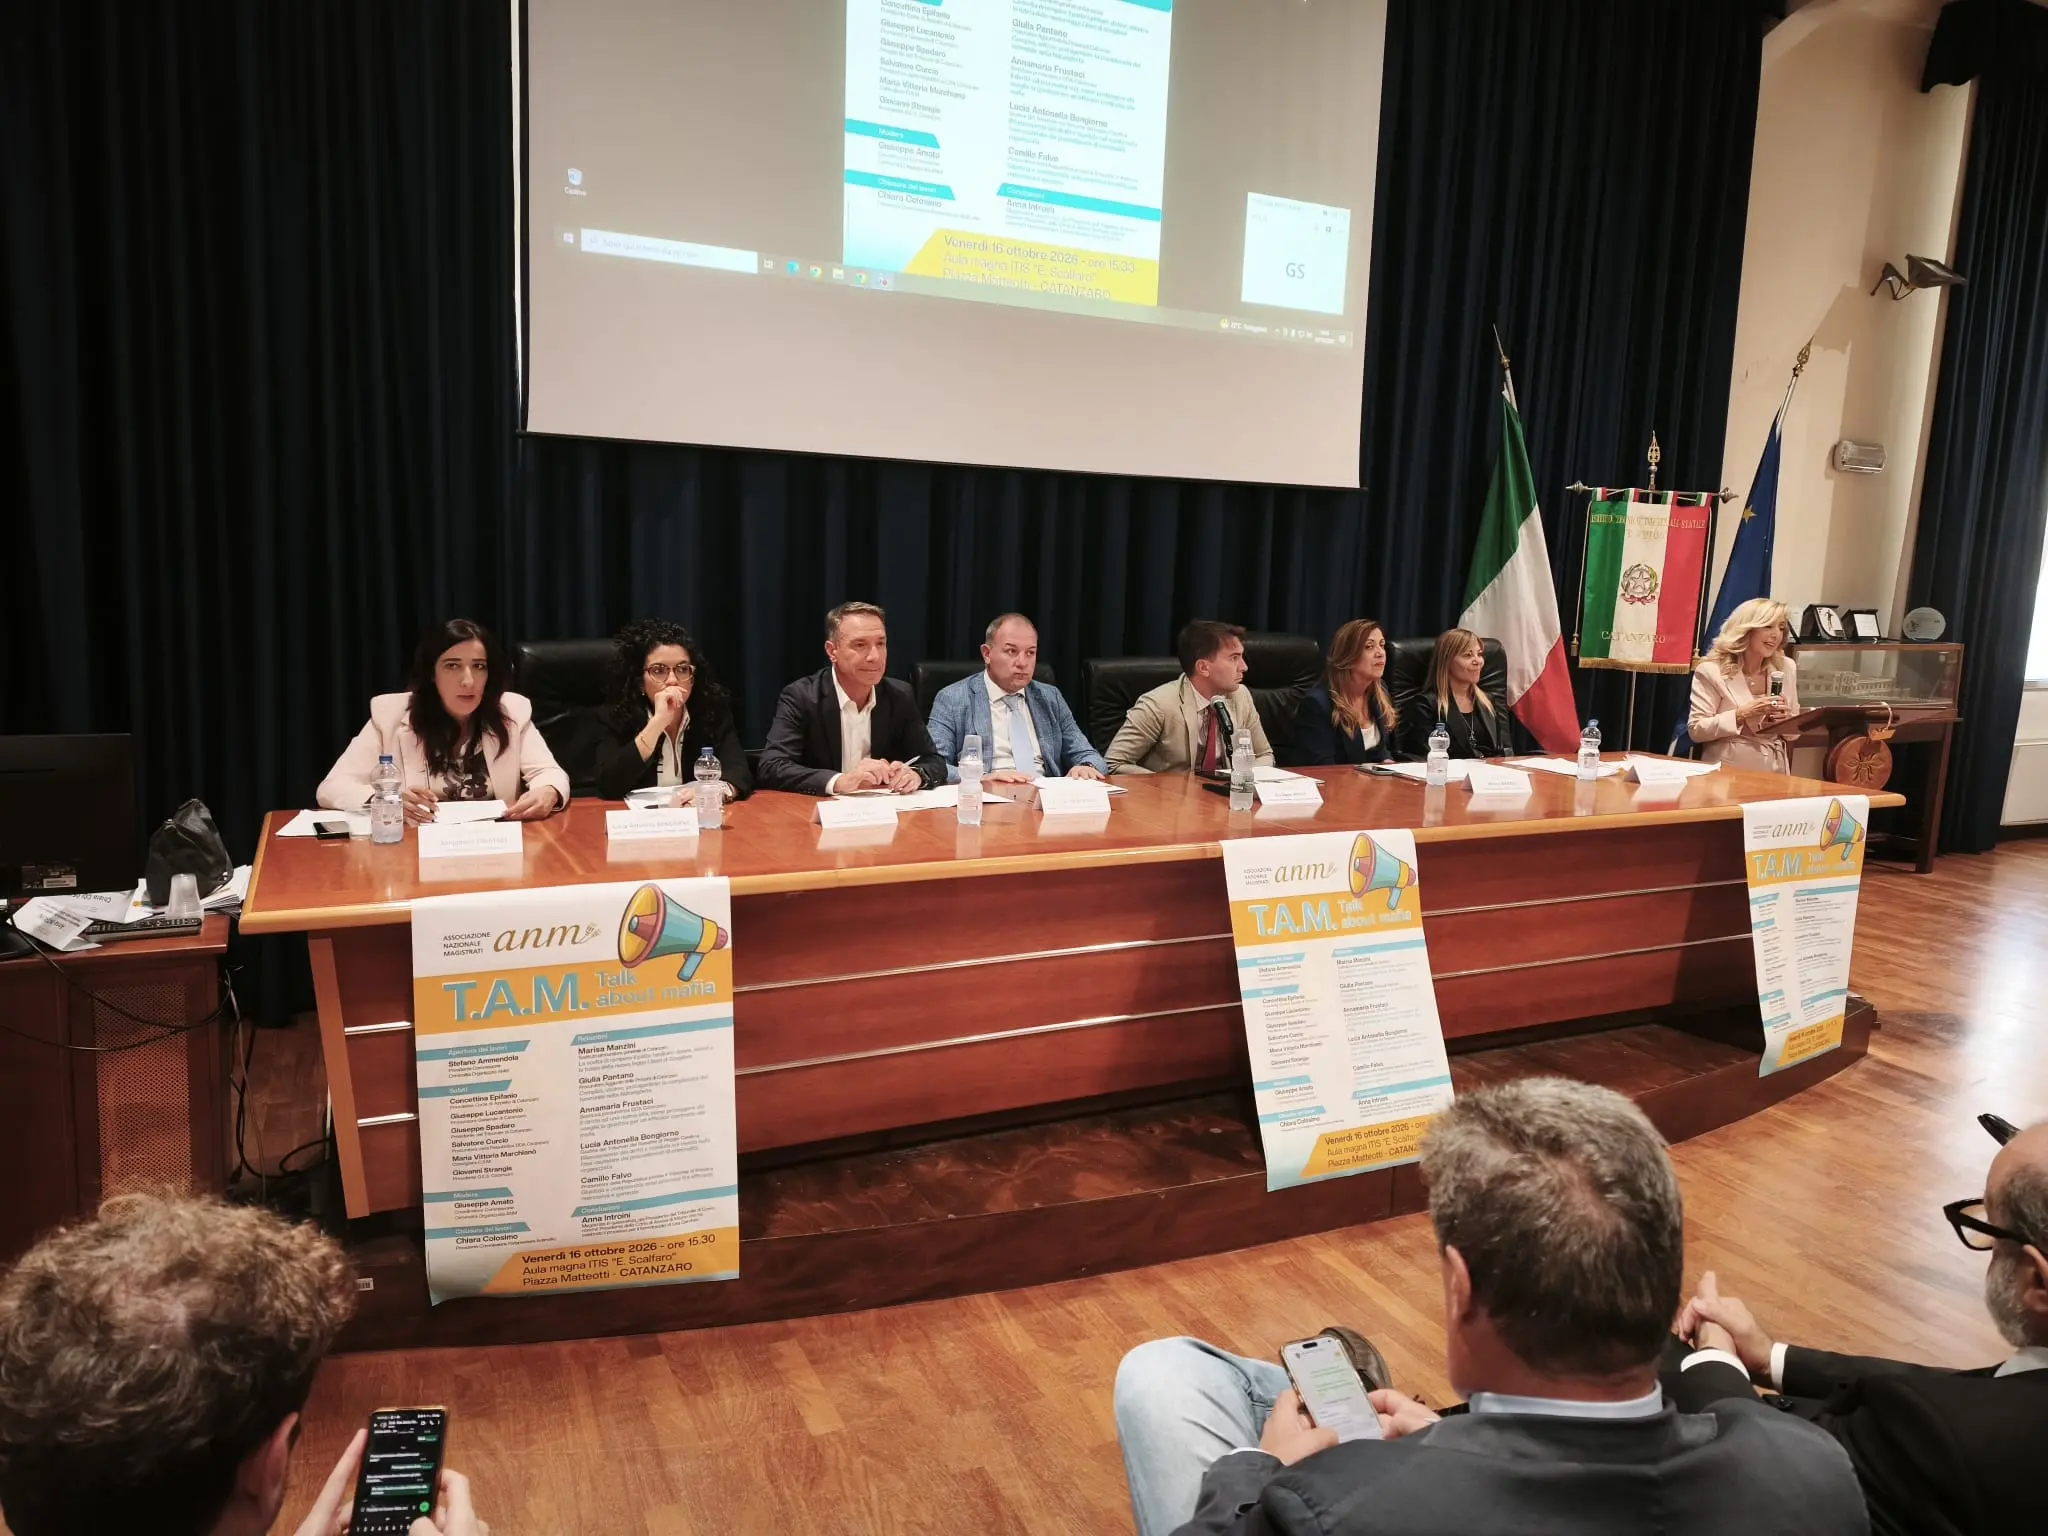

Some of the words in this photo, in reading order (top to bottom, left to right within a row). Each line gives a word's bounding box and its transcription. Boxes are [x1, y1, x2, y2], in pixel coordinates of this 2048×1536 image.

[1012, 18, 1034, 31] Giulia
[1036, 24, 1068, 38] Pantano
[992, 241, 1003, 254] 16
[1006, 246, 1048, 260] ottobre
[1285, 262, 1305, 280] GS
[1601, 631, 1665, 644] CATANZARO
[1772, 822, 1808, 838] anm
[1275, 862, 1326, 883] anm
[1752, 852, 1802, 880] T.A.M.
[1337, 900, 1364, 913] Talk
[1248, 900, 1337, 936] T.A.M.
[442, 931, 491, 941] ASSOCIAZIONE
[493, 924, 581, 953] anm
[443, 941, 481, 949] NAZIONALE
[443, 948, 484, 957] MAGISTRATI
[595, 968, 638, 988] Talk
[441, 972, 589, 1022] T.A.M.
[595, 985, 655, 1008] about
[661, 978, 716, 1001] mafia
[578, 1046, 604, 1055] Marisa
[606, 1042, 636, 1051] Manzini
[448, 1059, 476, 1068] Stefano
[478, 1055, 519, 1064] Ammendola
[602, 1072, 634, 1081] Pantano
[450, 1096, 488, 1104] Concettina
[490, 1093, 517, 1101] Epifanio
[580, 1103, 621, 1114] Annamaria
[622, 1098, 653, 1108] Frustaci
[450, 1112, 484, 1120] Giuseppe
[485, 1107, 523, 1117] Lucantonio
[451, 1125, 484, 1134] Giuseppe
[486, 1123, 515, 1131] Spadaro
[1355, 1130, 1362, 1138] 16
[1364, 1127, 1389, 1137] ottobre
[1391, 1123, 1409, 1133] 2026
[603, 1135, 638, 1146] Antonella
[641, 1130, 679, 1141] Bongiorno
[1345, 1144, 1367, 1155] magna
[1369, 1141, 1382, 1149] ITIS
[474, 1152, 499, 1160] Vittoria
[1328, 1160, 1350, 1168] Piazza
[1352, 1153, 1383, 1163] Matteotti
[1389, 1145, 1418, 1156] CATANZ
[453, 1168, 482, 1176] Giovanni
[581, 1175, 609, 1184] Camillo
[611, 1172, 632, 1180] Falvo
[454, 1201, 488, 1209] Giuseppe
[582, 1216, 602, 1224] Anna
[604, 1212, 631, 1221] Introini
[483, 1234, 518, 1243] Colosimo
[522, 1251, 566, 1264] Venerdì
[569, 1250, 581, 1259] 16
[584, 1246, 625, 1259] ottobre
[628, 1243, 657, 1253] 2026
[667, 1241, 685, 1250] ore
[688, 1233, 716, 1246] 15.30
[523, 1265, 547, 1275] Aula
[550, 1261, 586, 1273] magna
[589, 1259, 609, 1268] ITIS
[628, 1251, 677, 1265] Scalfaro"
[523, 1276, 558, 1287] Piazza
[560, 1271, 610, 1283] Matteotti
[619, 1262, 693, 1277] CATANZARO
